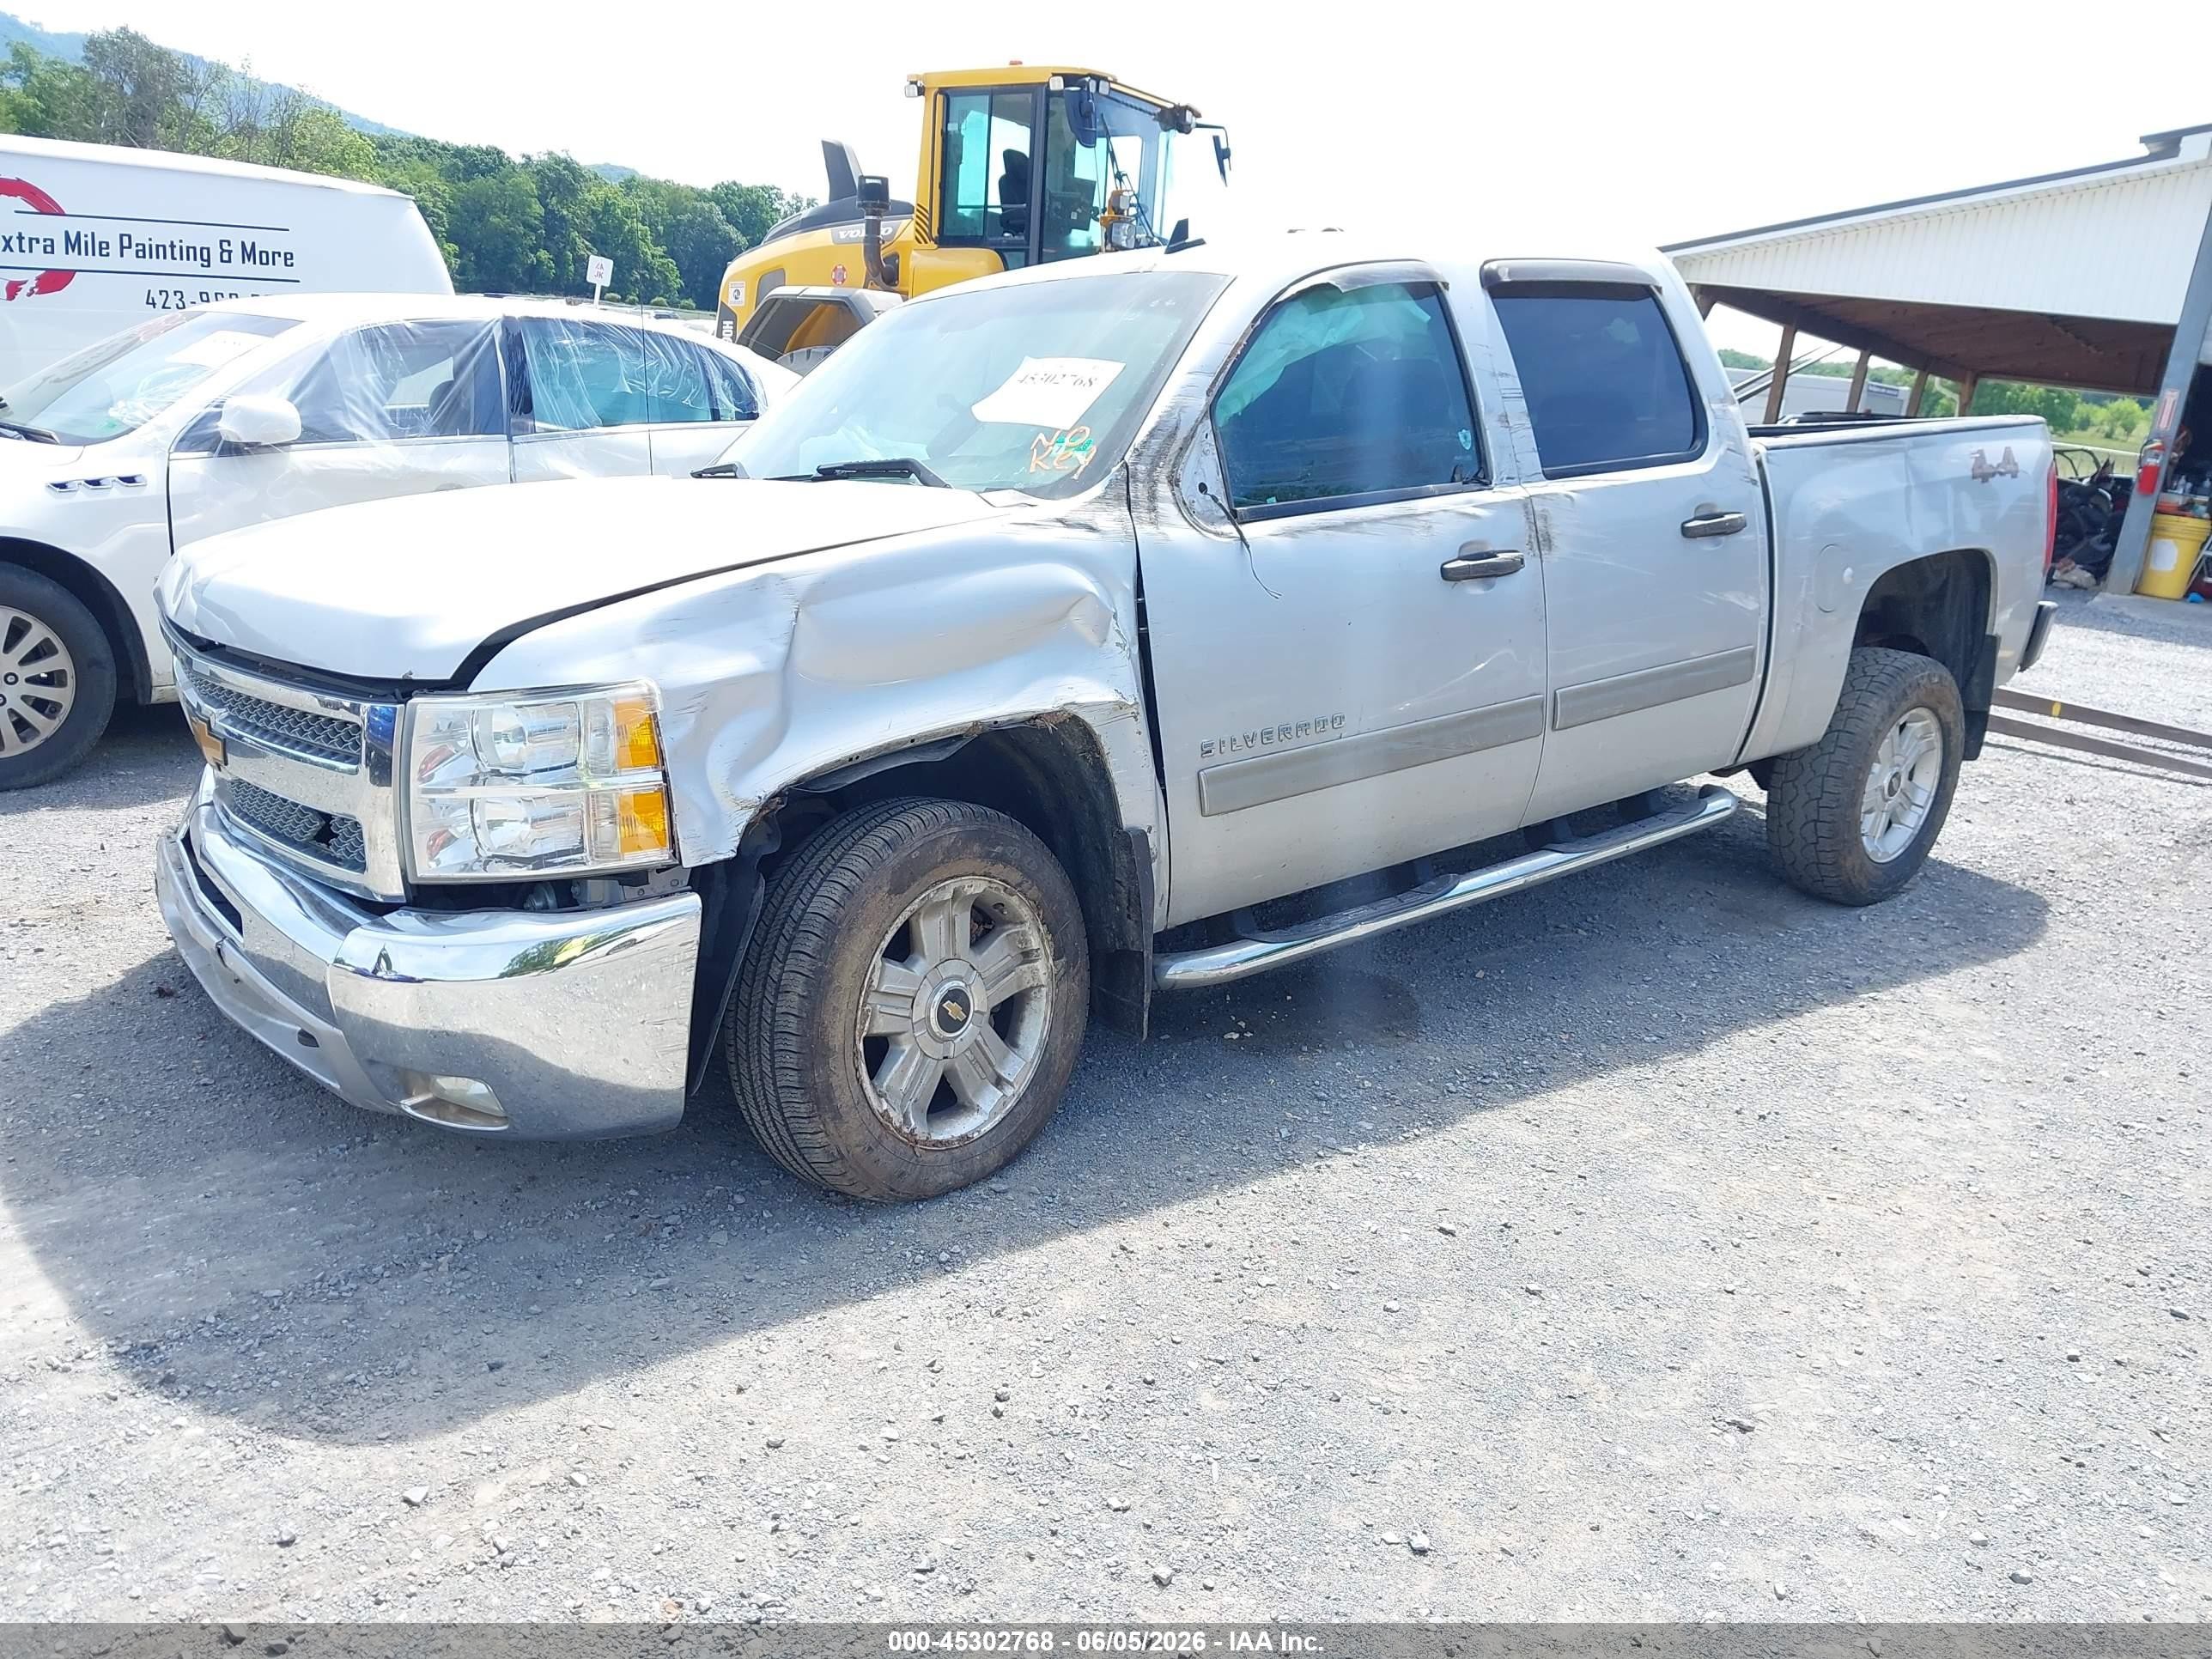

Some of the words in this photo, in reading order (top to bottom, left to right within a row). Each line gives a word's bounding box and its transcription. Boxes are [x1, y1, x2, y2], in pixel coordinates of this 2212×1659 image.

[64, 229, 110, 258] Mile
[118, 233, 211, 269] Painting
[219, 239, 234, 264] &
[241, 240, 295, 268] More
[838, 227, 893, 240] VOLO
[1030, 426, 1091, 450] NO
[1200, 712, 1346, 758] SILVERADO
